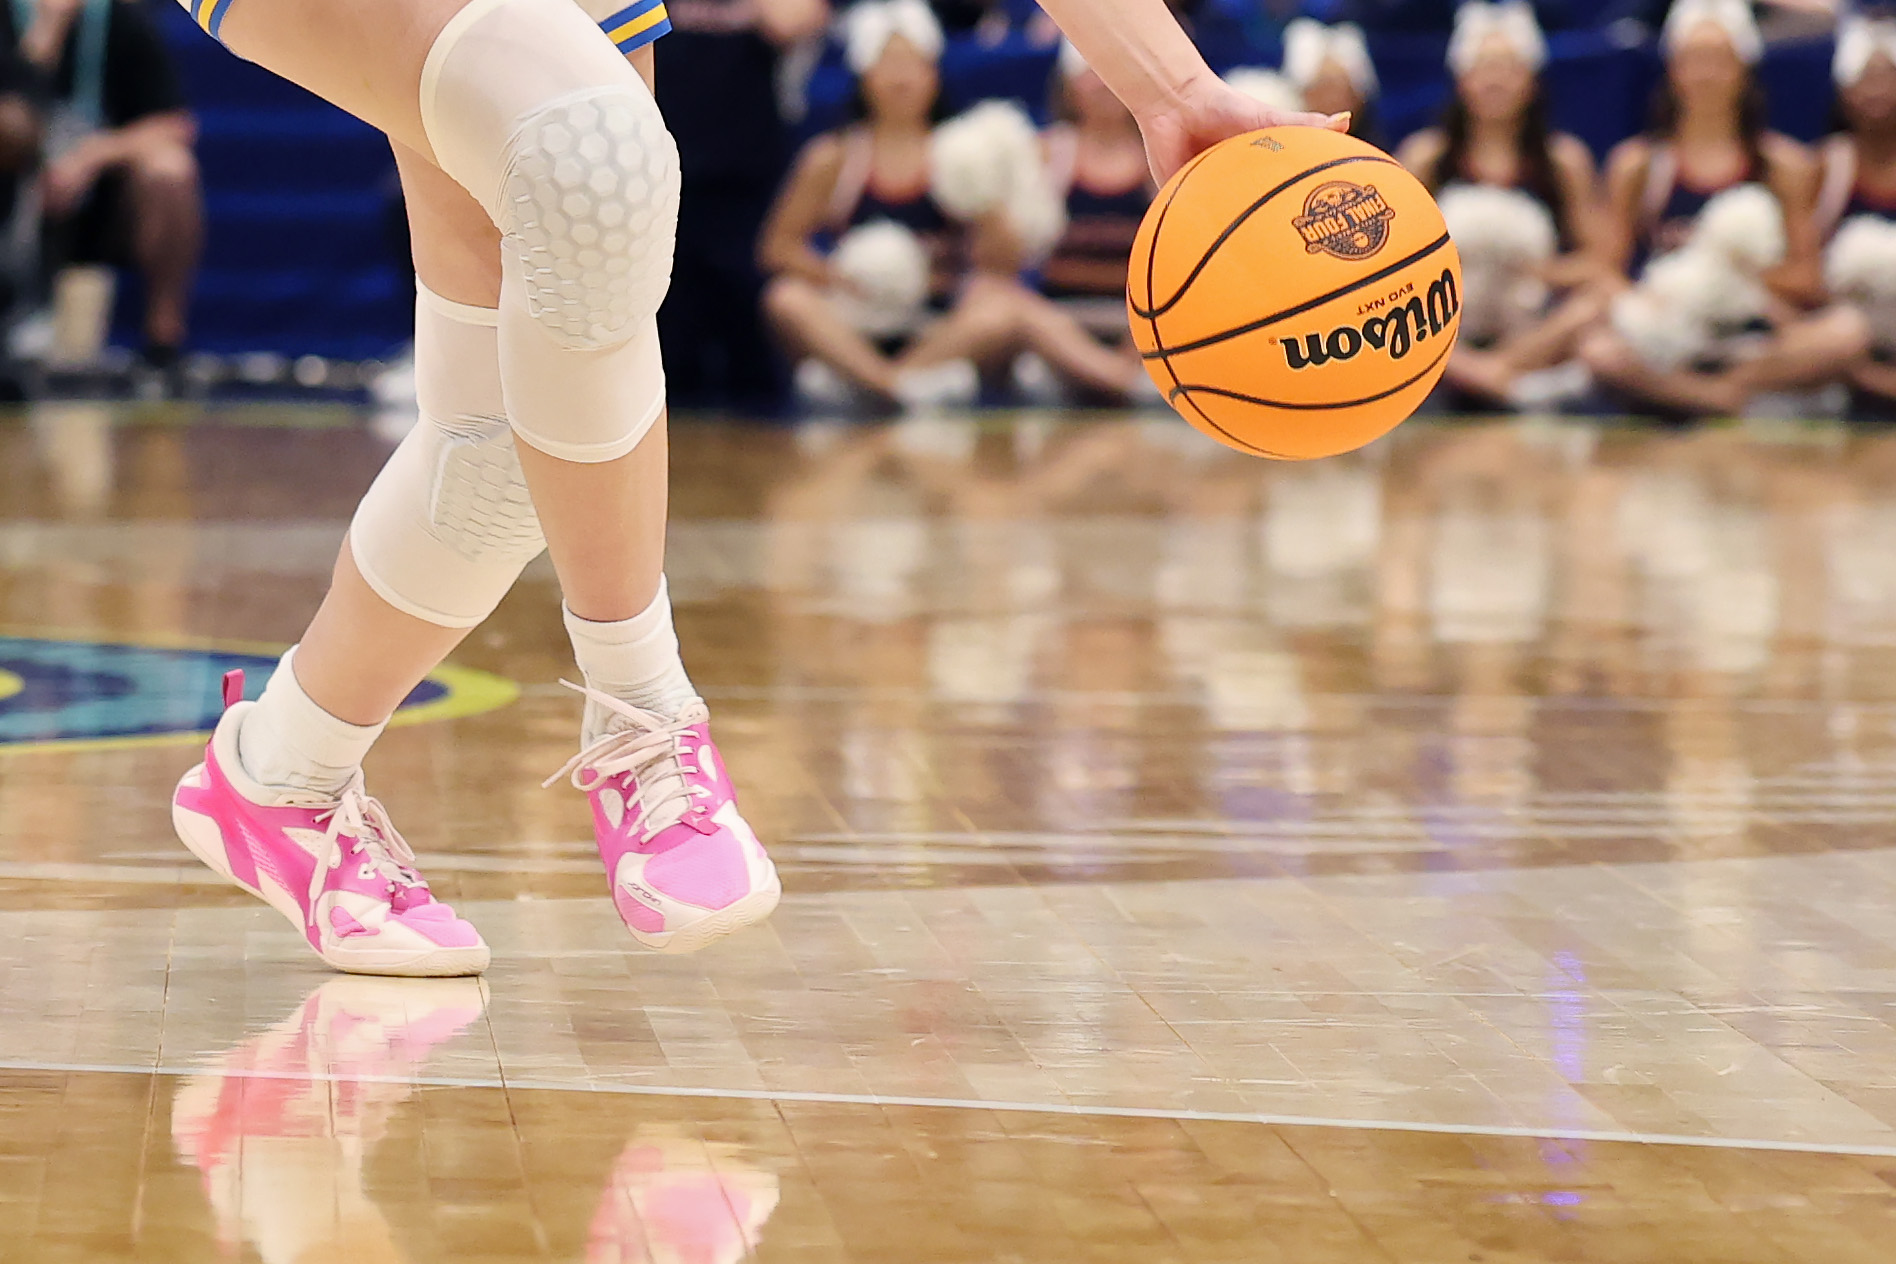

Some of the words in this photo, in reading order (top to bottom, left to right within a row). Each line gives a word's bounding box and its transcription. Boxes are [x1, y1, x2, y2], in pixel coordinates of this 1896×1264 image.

[1345, 193, 1387, 224] FINAL
[1300, 212, 1350, 242] FOUR
[1356, 296, 1386, 316] NXT
[1388, 281, 1414, 302] EVO
[1279, 267, 1459, 370] Wilson
